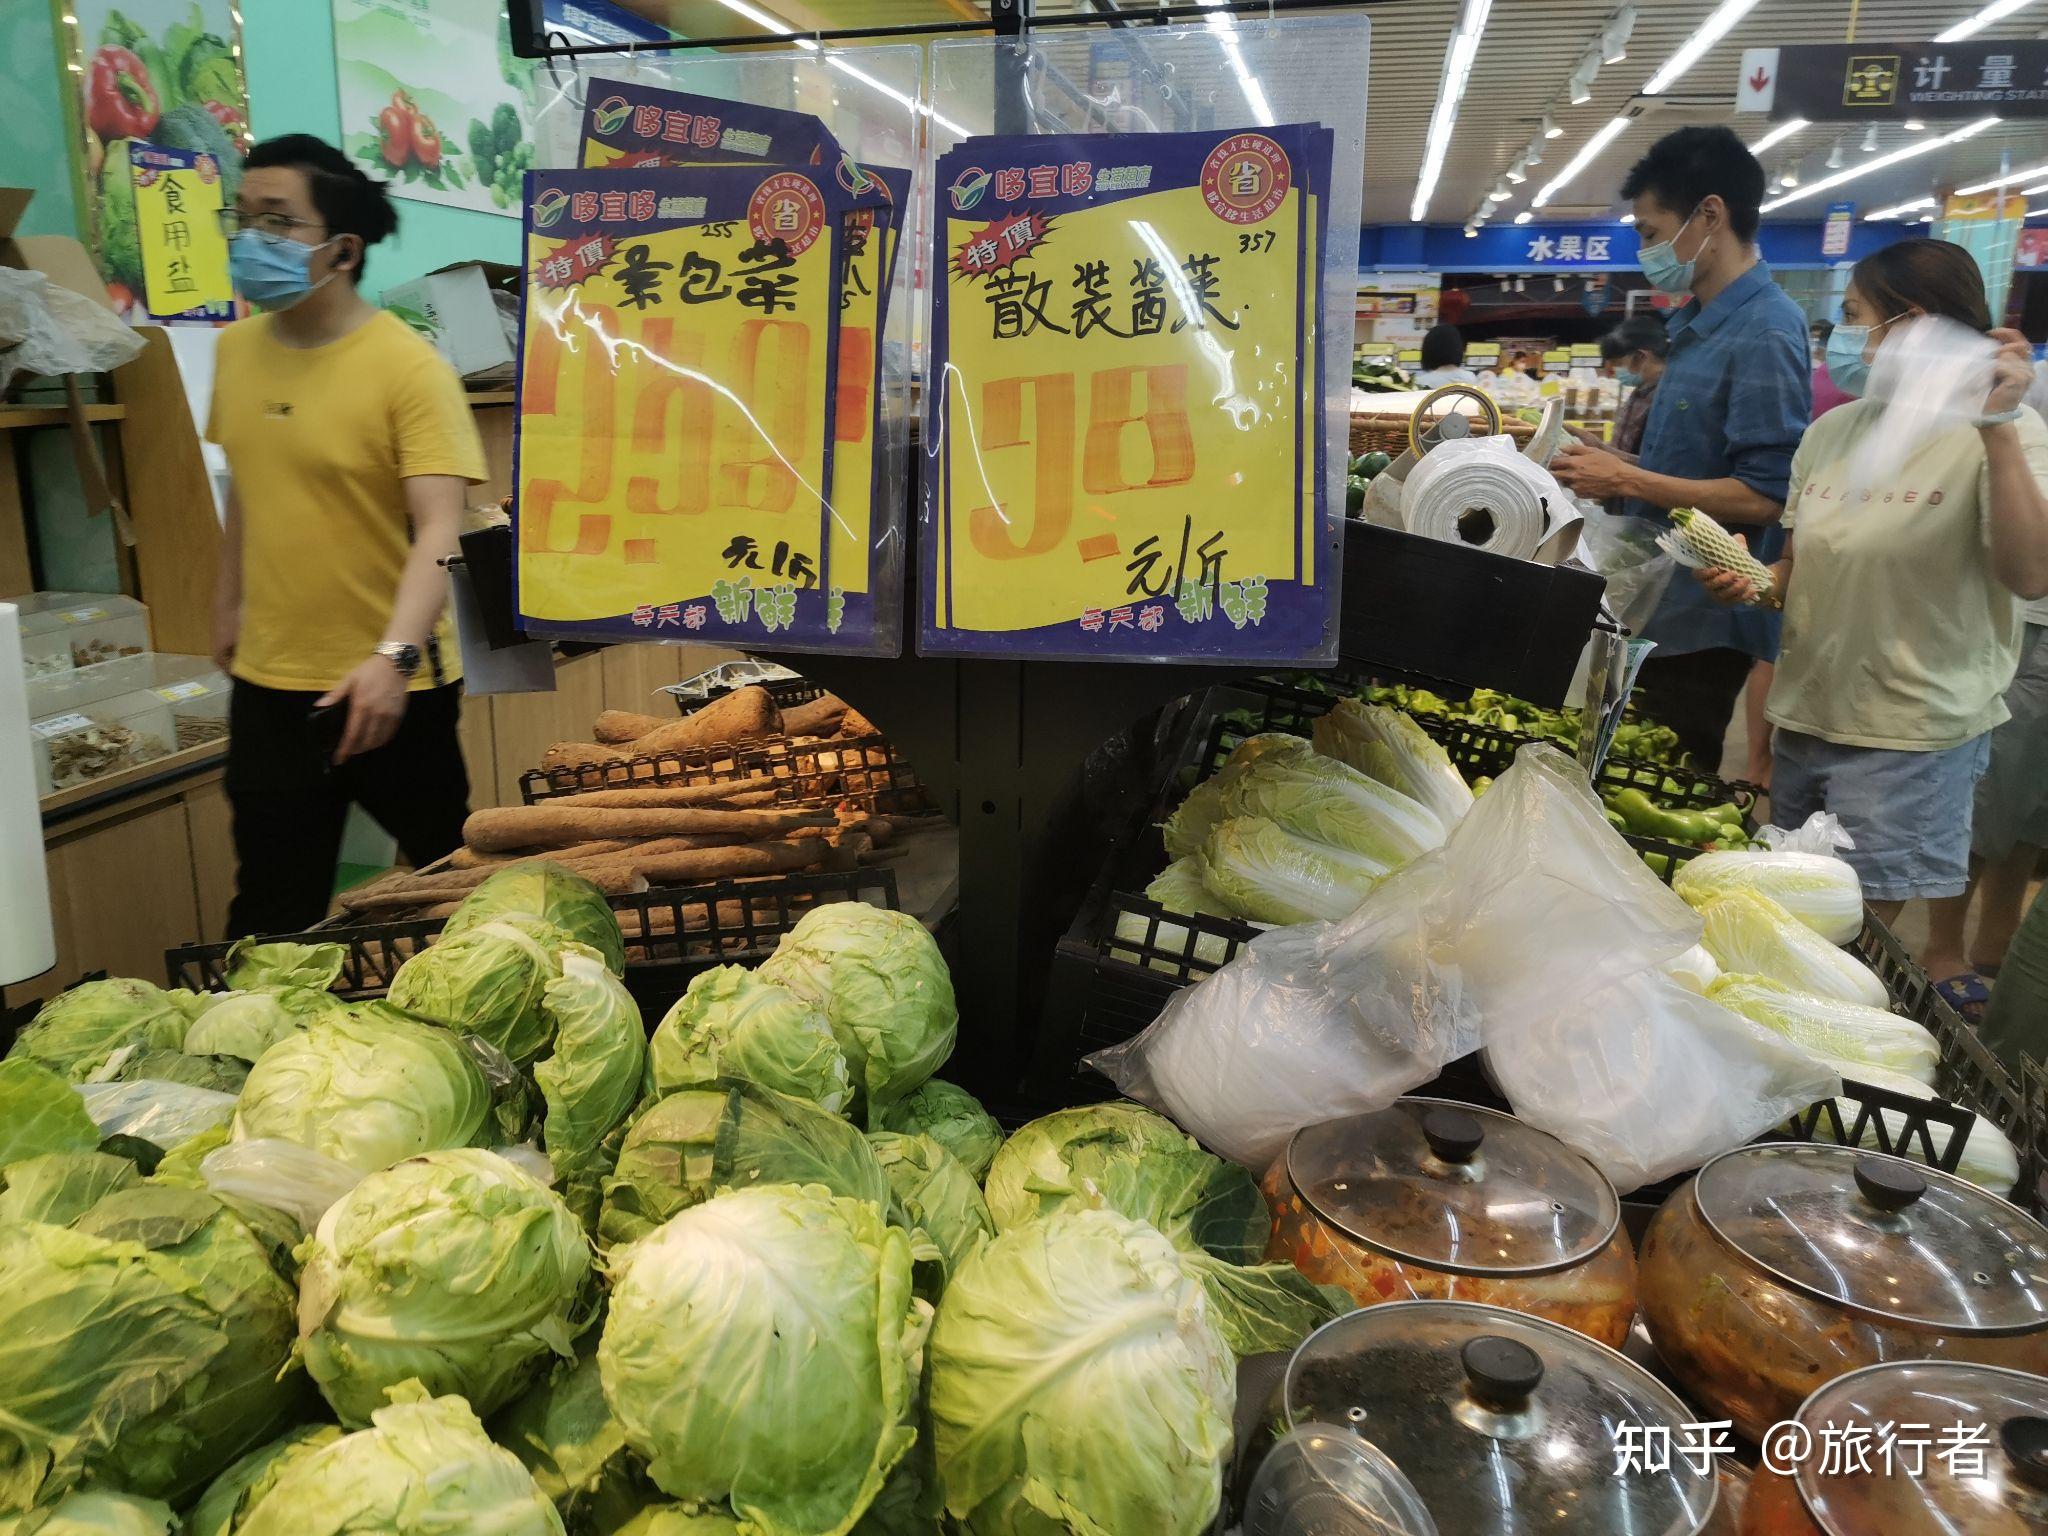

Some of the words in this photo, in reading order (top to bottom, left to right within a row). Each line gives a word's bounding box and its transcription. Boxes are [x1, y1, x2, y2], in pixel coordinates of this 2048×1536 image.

[633, 105, 721, 148] 哆宜哆
[995, 161, 1092, 202] 哆宜哆
[1229, 160, 1262, 196] 省
[571, 190, 656, 222] 哆宜哆
[159, 173, 199, 294] 食用盐
[701, 221, 739, 239] 255
[1239, 230, 1276, 253] 357
[1526, 235, 1612, 261] 水果区
[1126, 514, 1229, 604] 元/斤
